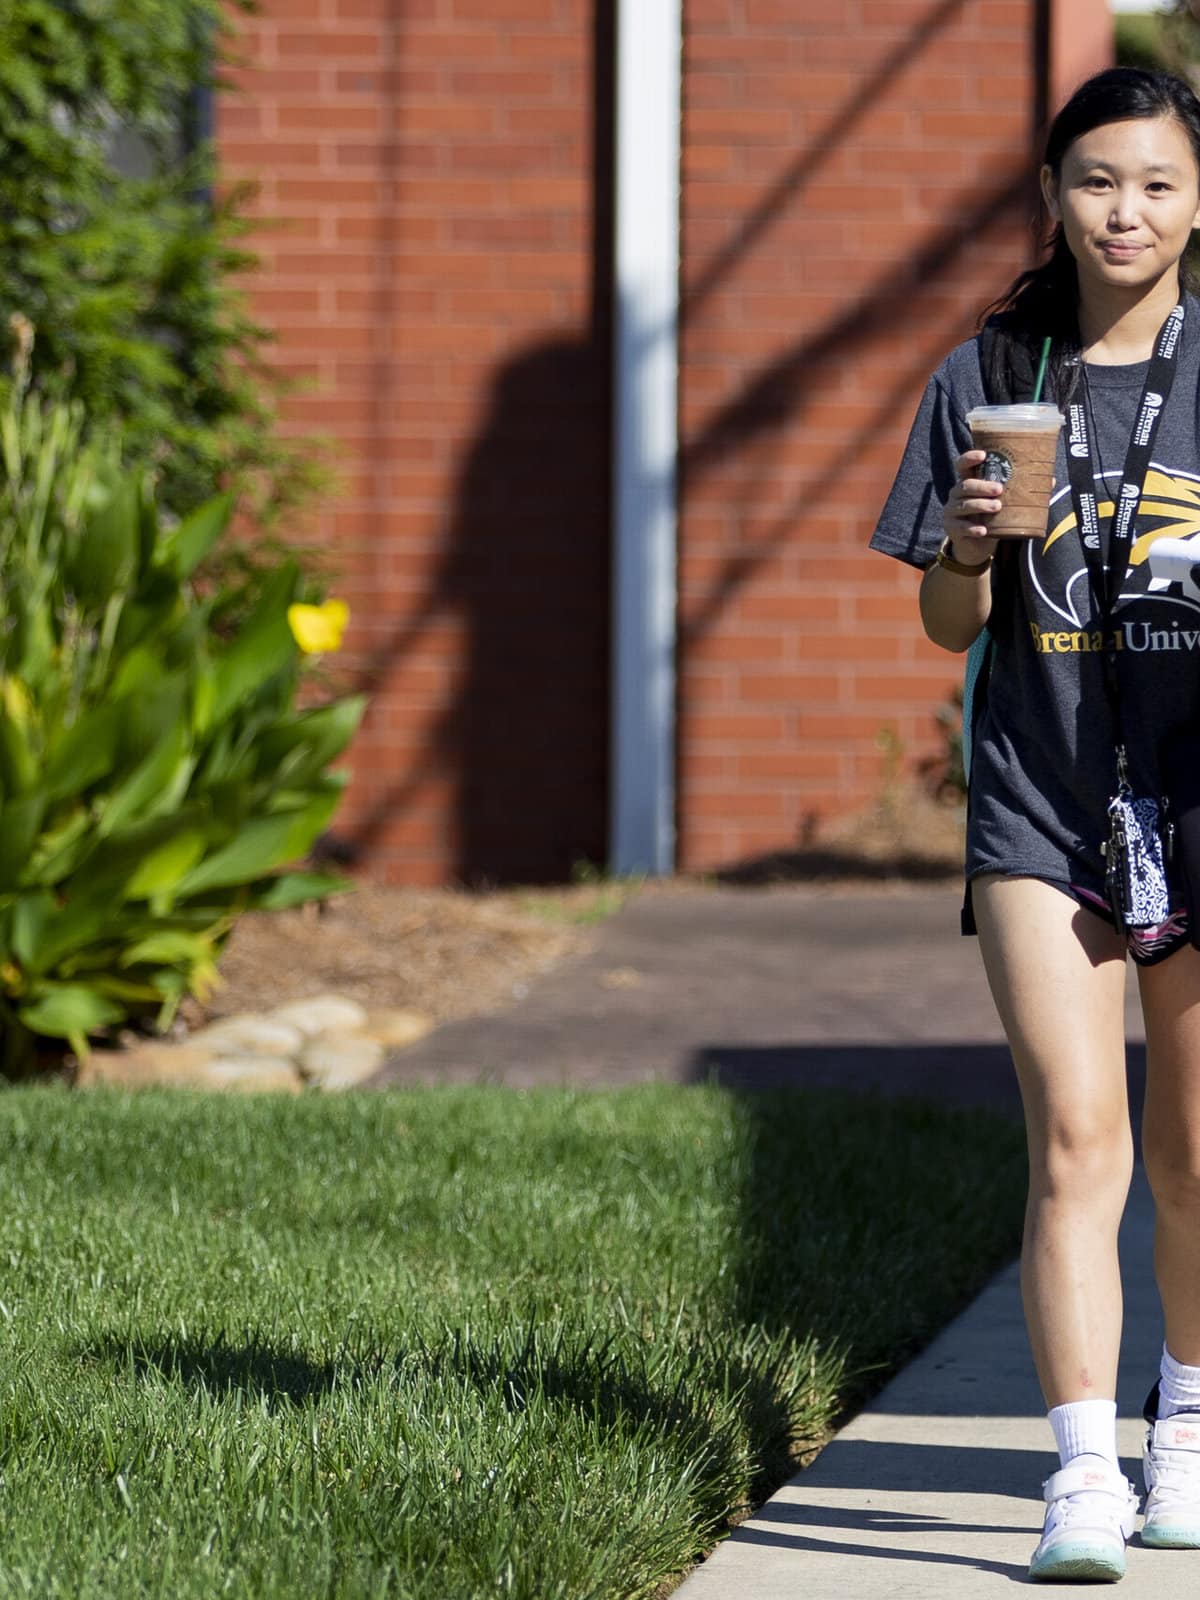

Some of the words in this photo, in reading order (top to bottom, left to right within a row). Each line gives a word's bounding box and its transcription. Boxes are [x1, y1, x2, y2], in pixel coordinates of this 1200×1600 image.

[1163, 319, 1182, 359] Brenau
[1069, 405, 1082, 443] Brenau
[1139, 408, 1160, 447] Brenau
[1080, 494, 1093, 534] Brenau
[1120, 500, 1137, 538] Brenau
